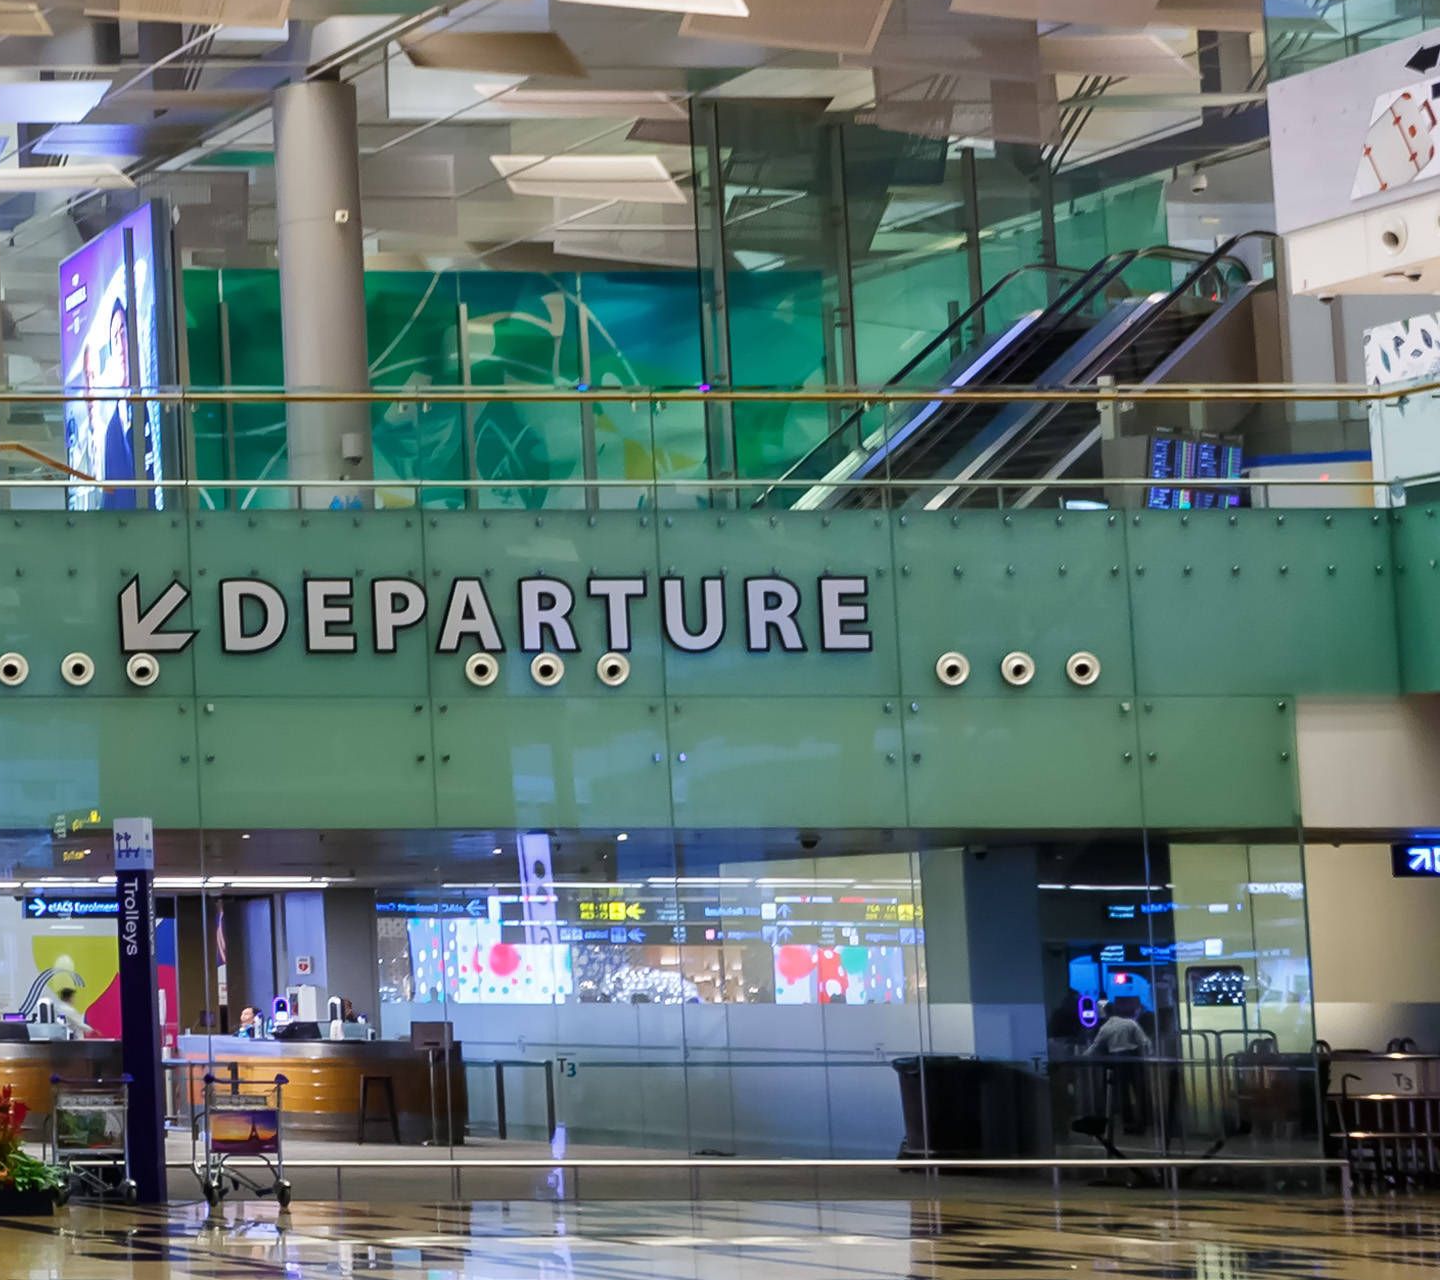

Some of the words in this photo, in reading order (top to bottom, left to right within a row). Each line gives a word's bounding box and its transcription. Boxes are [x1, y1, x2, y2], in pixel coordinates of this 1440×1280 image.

[219, 577, 873, 654] DEPARTURE
[122, 878, 140, 956] Trolleys
[556, 1057, 577, 1078] T3
[1391, 1072, 1413, 1092] T3
